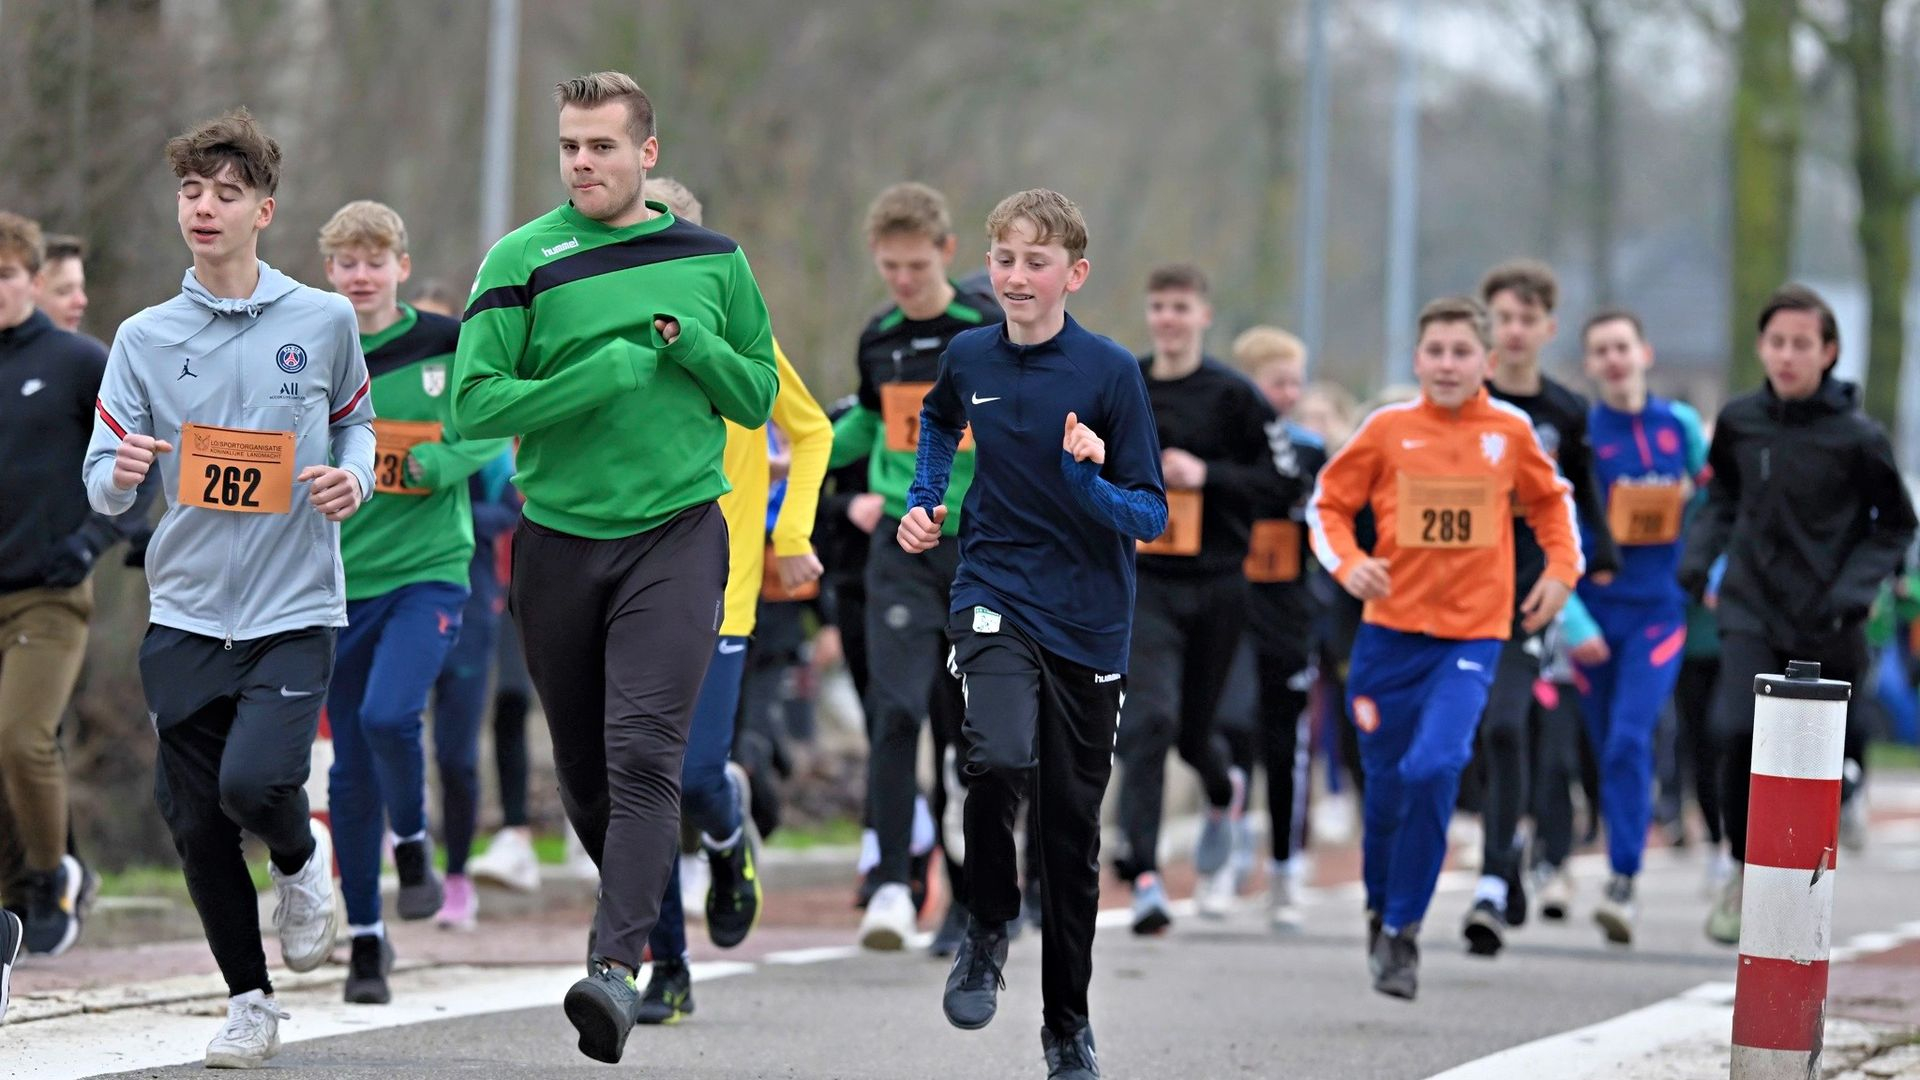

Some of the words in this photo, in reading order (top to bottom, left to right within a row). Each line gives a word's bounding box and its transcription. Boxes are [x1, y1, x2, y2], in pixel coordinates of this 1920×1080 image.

[541, 236, 579, 257] hummel
[203, 464, 261, 507] 262
[1422, 509, 1471, 543] 289
